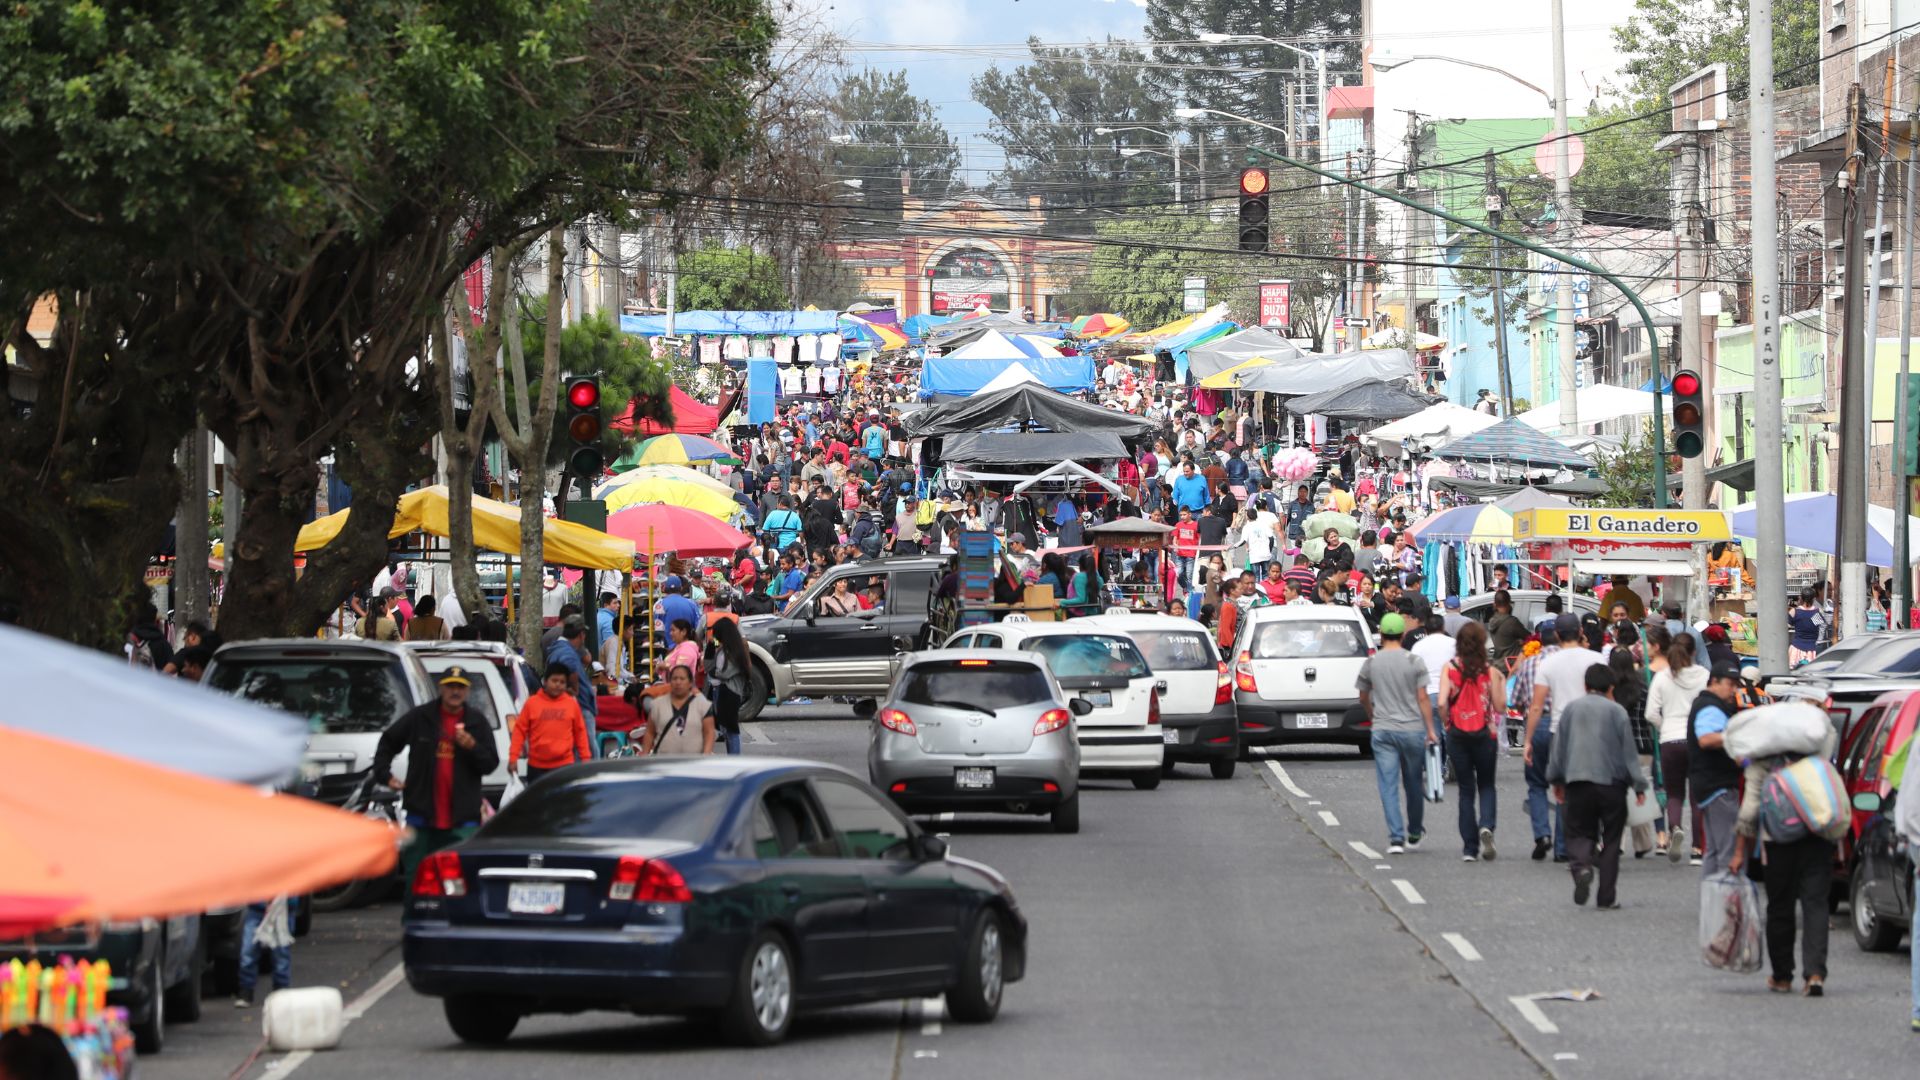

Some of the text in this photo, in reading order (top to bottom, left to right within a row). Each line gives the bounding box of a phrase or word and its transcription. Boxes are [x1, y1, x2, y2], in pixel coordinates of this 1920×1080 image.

[1262, 286, 1288, 297] CHAPÍN
[1263, 305, 1286, 316] BUZO
[1567, 514, 1699, 533] El Ganadero
